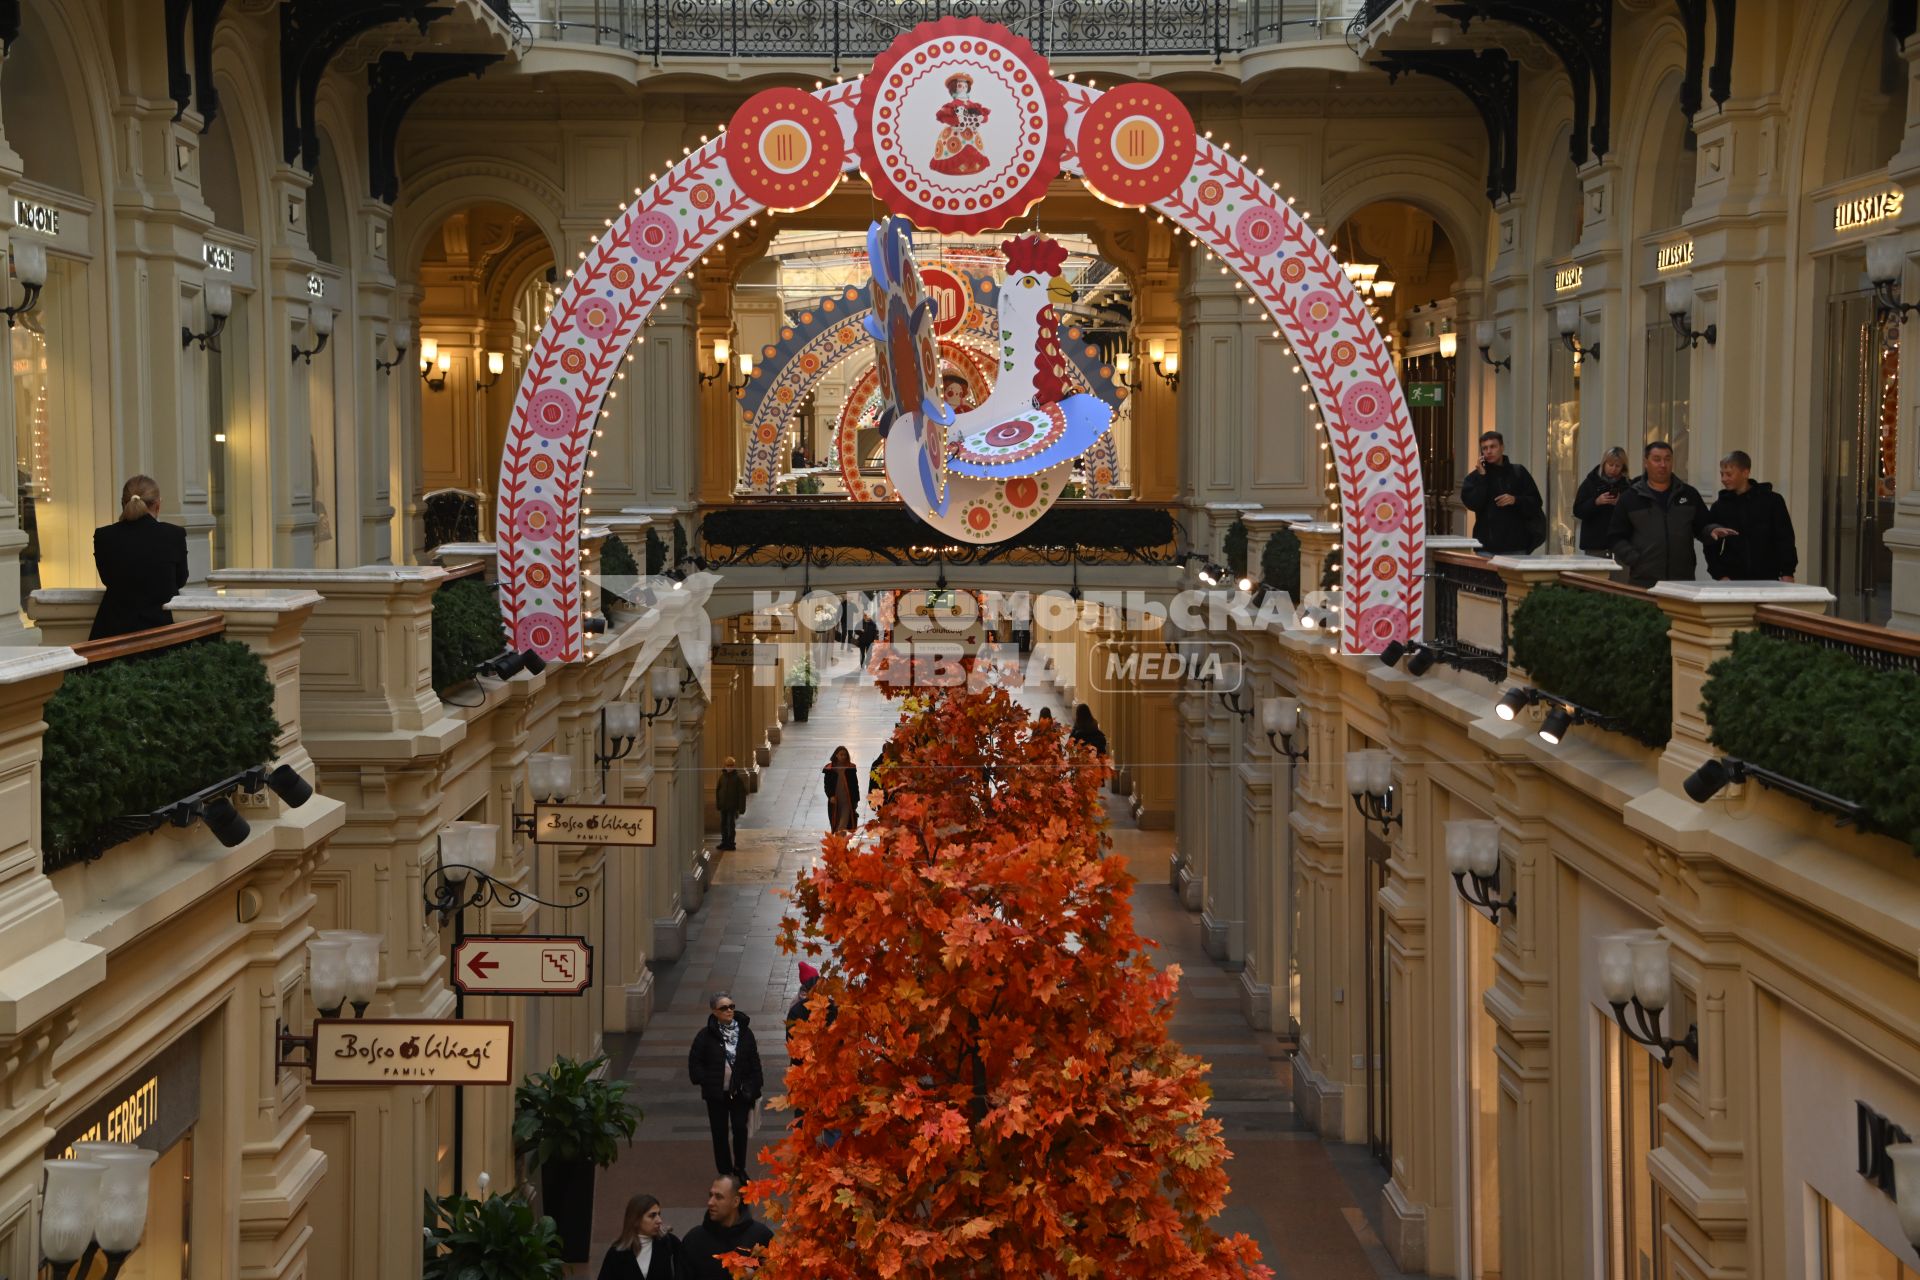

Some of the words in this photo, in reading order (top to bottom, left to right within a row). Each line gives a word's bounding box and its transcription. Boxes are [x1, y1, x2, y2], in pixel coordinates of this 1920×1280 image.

[1833, 194, 1884, 229] ELLASSAY
[547, 813, 584, 832] Bosco
[334, 1034, 395, 1065] Bosco
[384, 1067, 436, 1076] FAMILY
